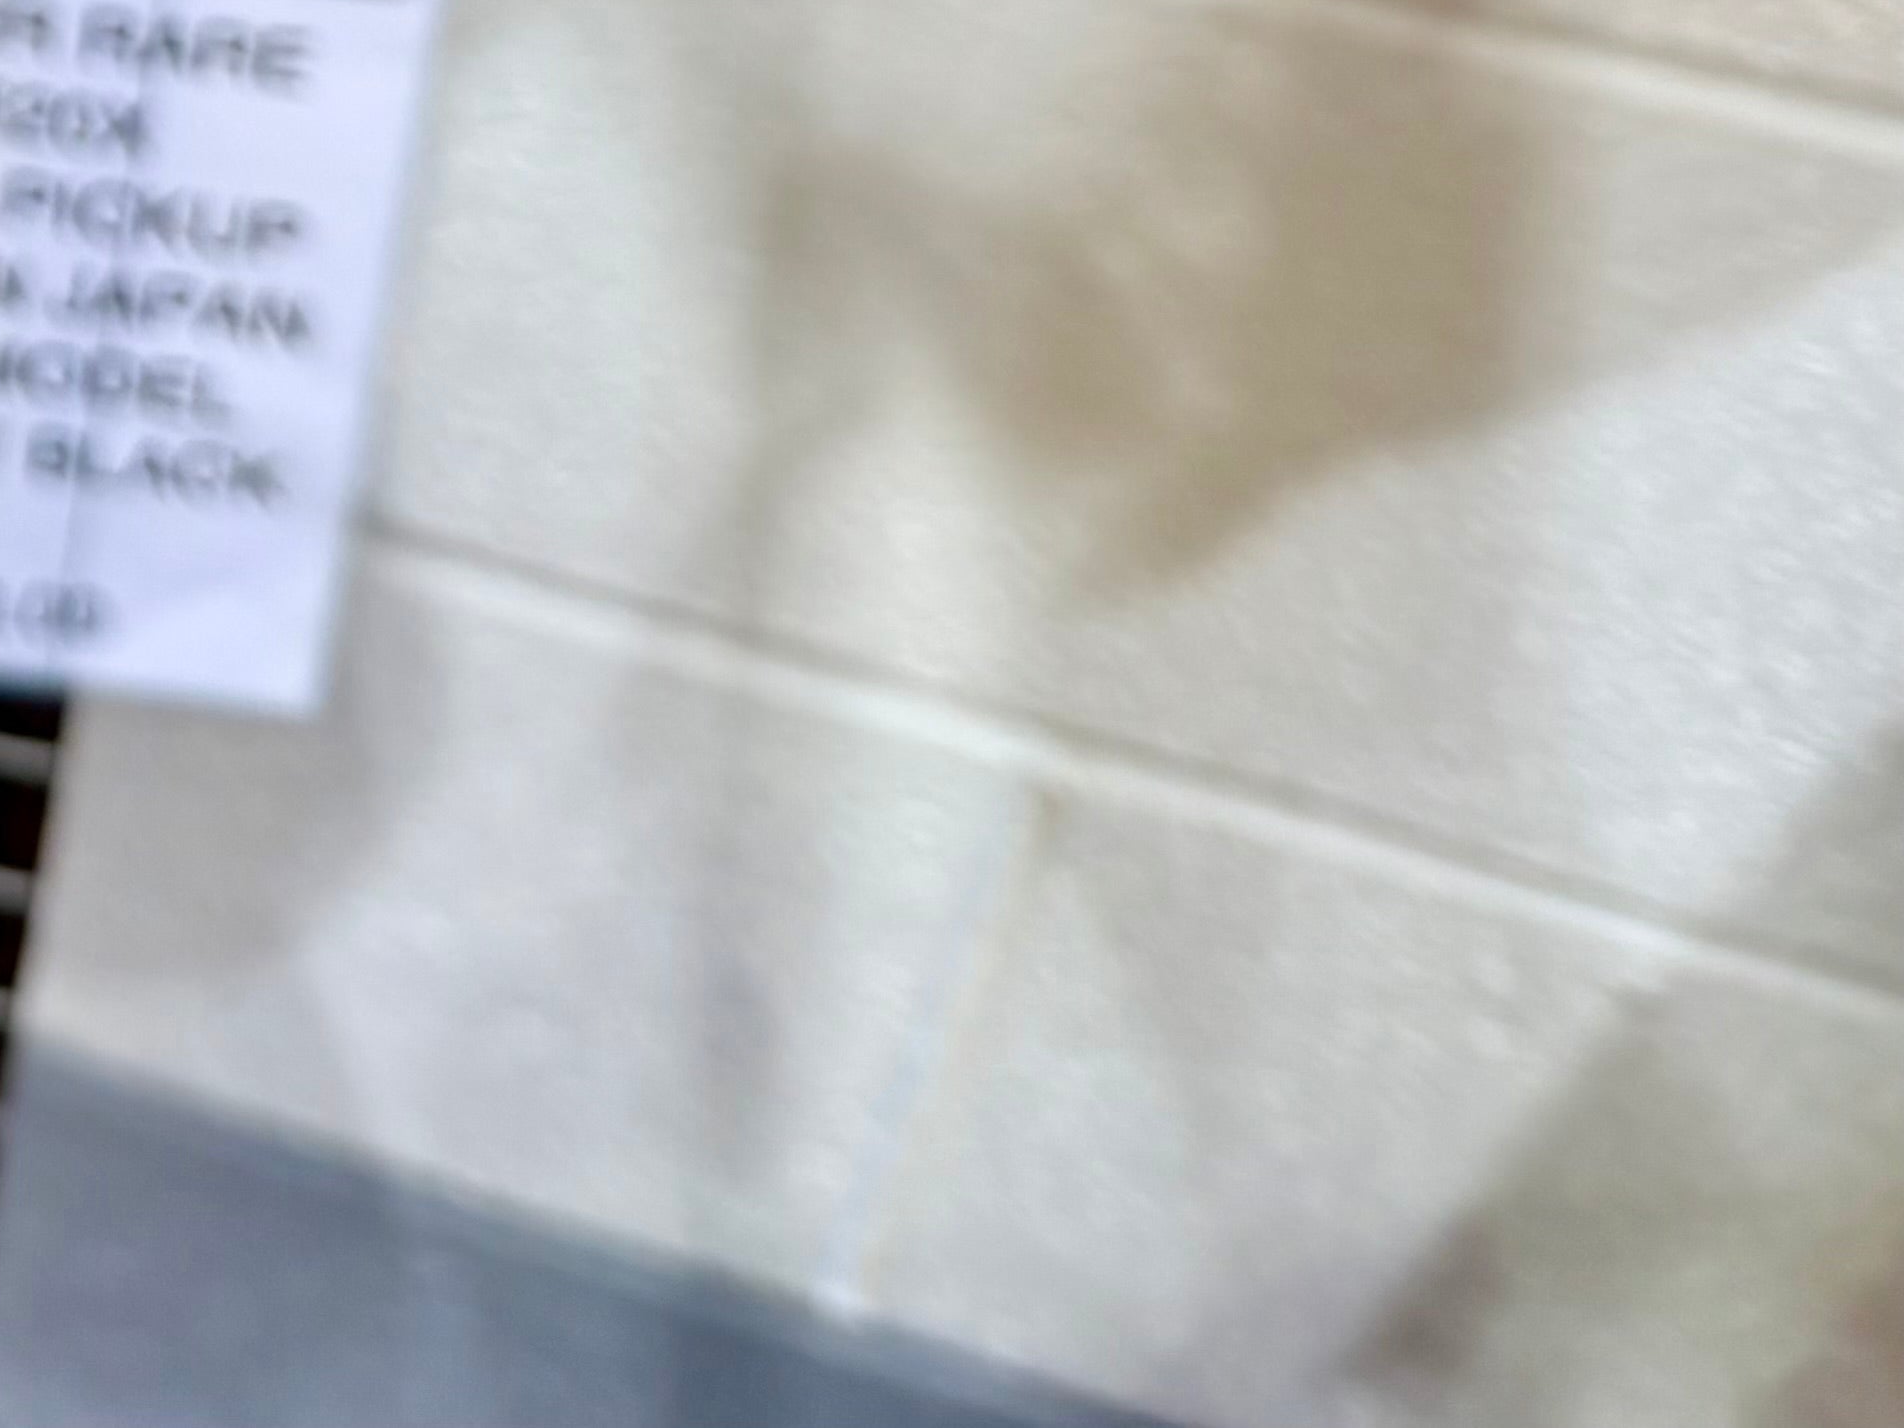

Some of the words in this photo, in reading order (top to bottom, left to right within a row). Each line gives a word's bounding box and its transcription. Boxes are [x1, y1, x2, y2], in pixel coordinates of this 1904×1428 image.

[80, 0, 311, 96] RARE
[0, 156, 306, 256] PICKUP
[56, 254, 312, 351] JAPAN
[23, 420, 287, 510] BLACK
